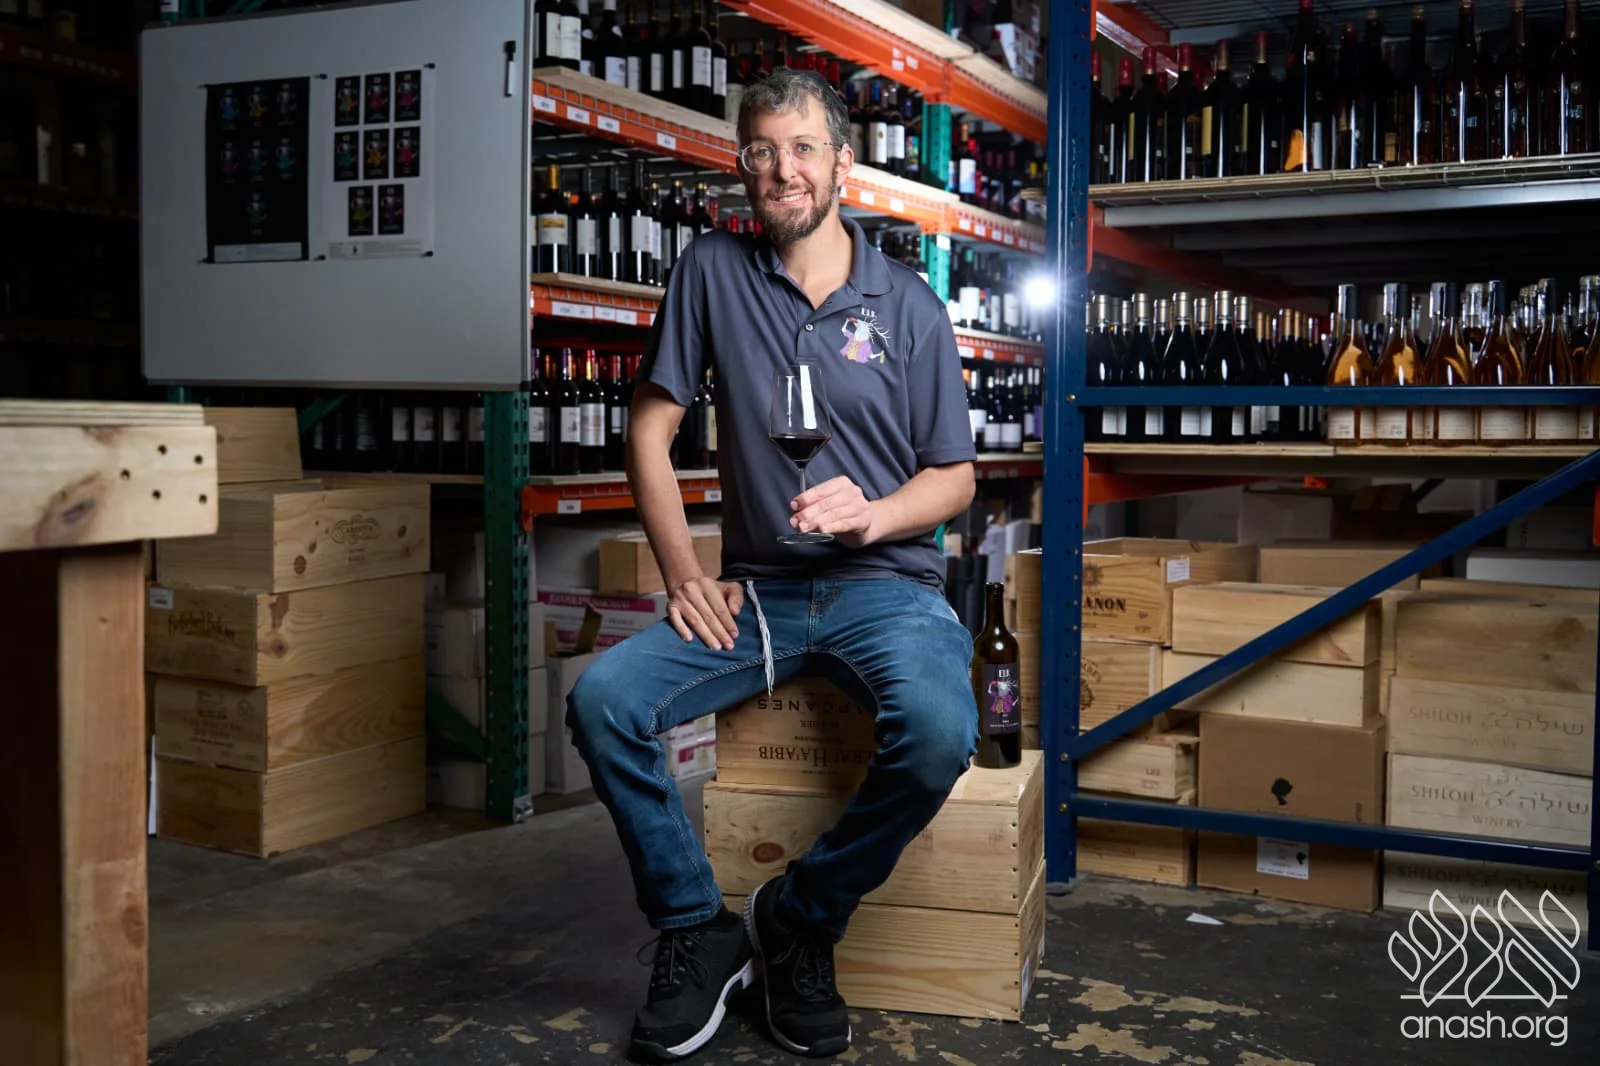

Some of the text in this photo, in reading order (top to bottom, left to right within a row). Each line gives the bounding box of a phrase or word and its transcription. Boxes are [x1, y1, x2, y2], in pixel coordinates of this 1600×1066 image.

[1083, 596, 1126, 612] ANON
[1409, 707, 1472, 726] SHILOH
[1411, 785, 1474, 803] SHILOH
[1472, 814, 1523, 829] WINERY
[1398, 865, 1461, 882] SHILOH
[1458, 893, 1508, 908] WINERY
